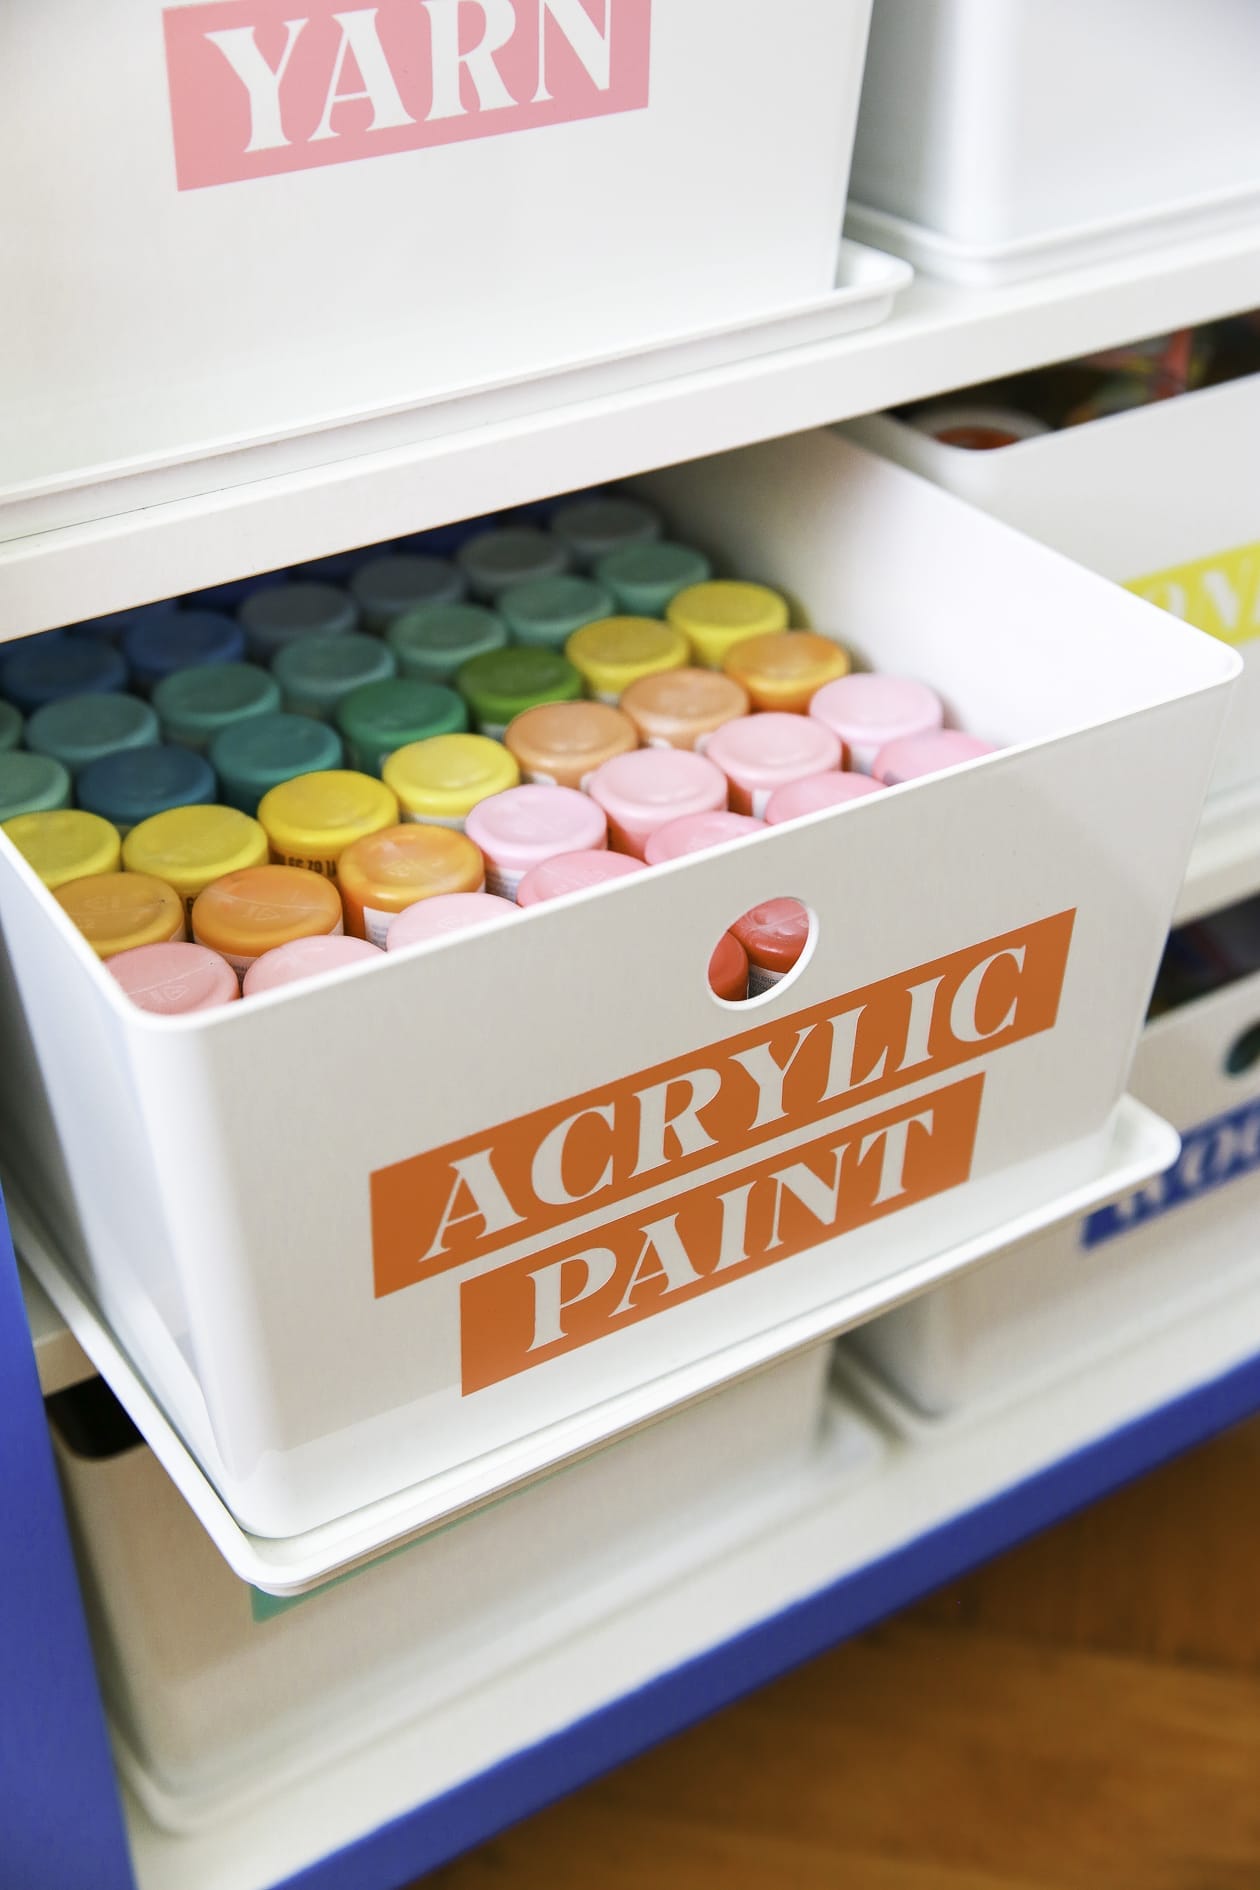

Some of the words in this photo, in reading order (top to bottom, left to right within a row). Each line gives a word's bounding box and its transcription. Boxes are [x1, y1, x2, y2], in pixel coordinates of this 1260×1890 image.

[203, 0, 611, 153] YARN
[419, 945, 1026, 1262] ACRYLIC
[526, 1109, 933, 1353] PAINT
